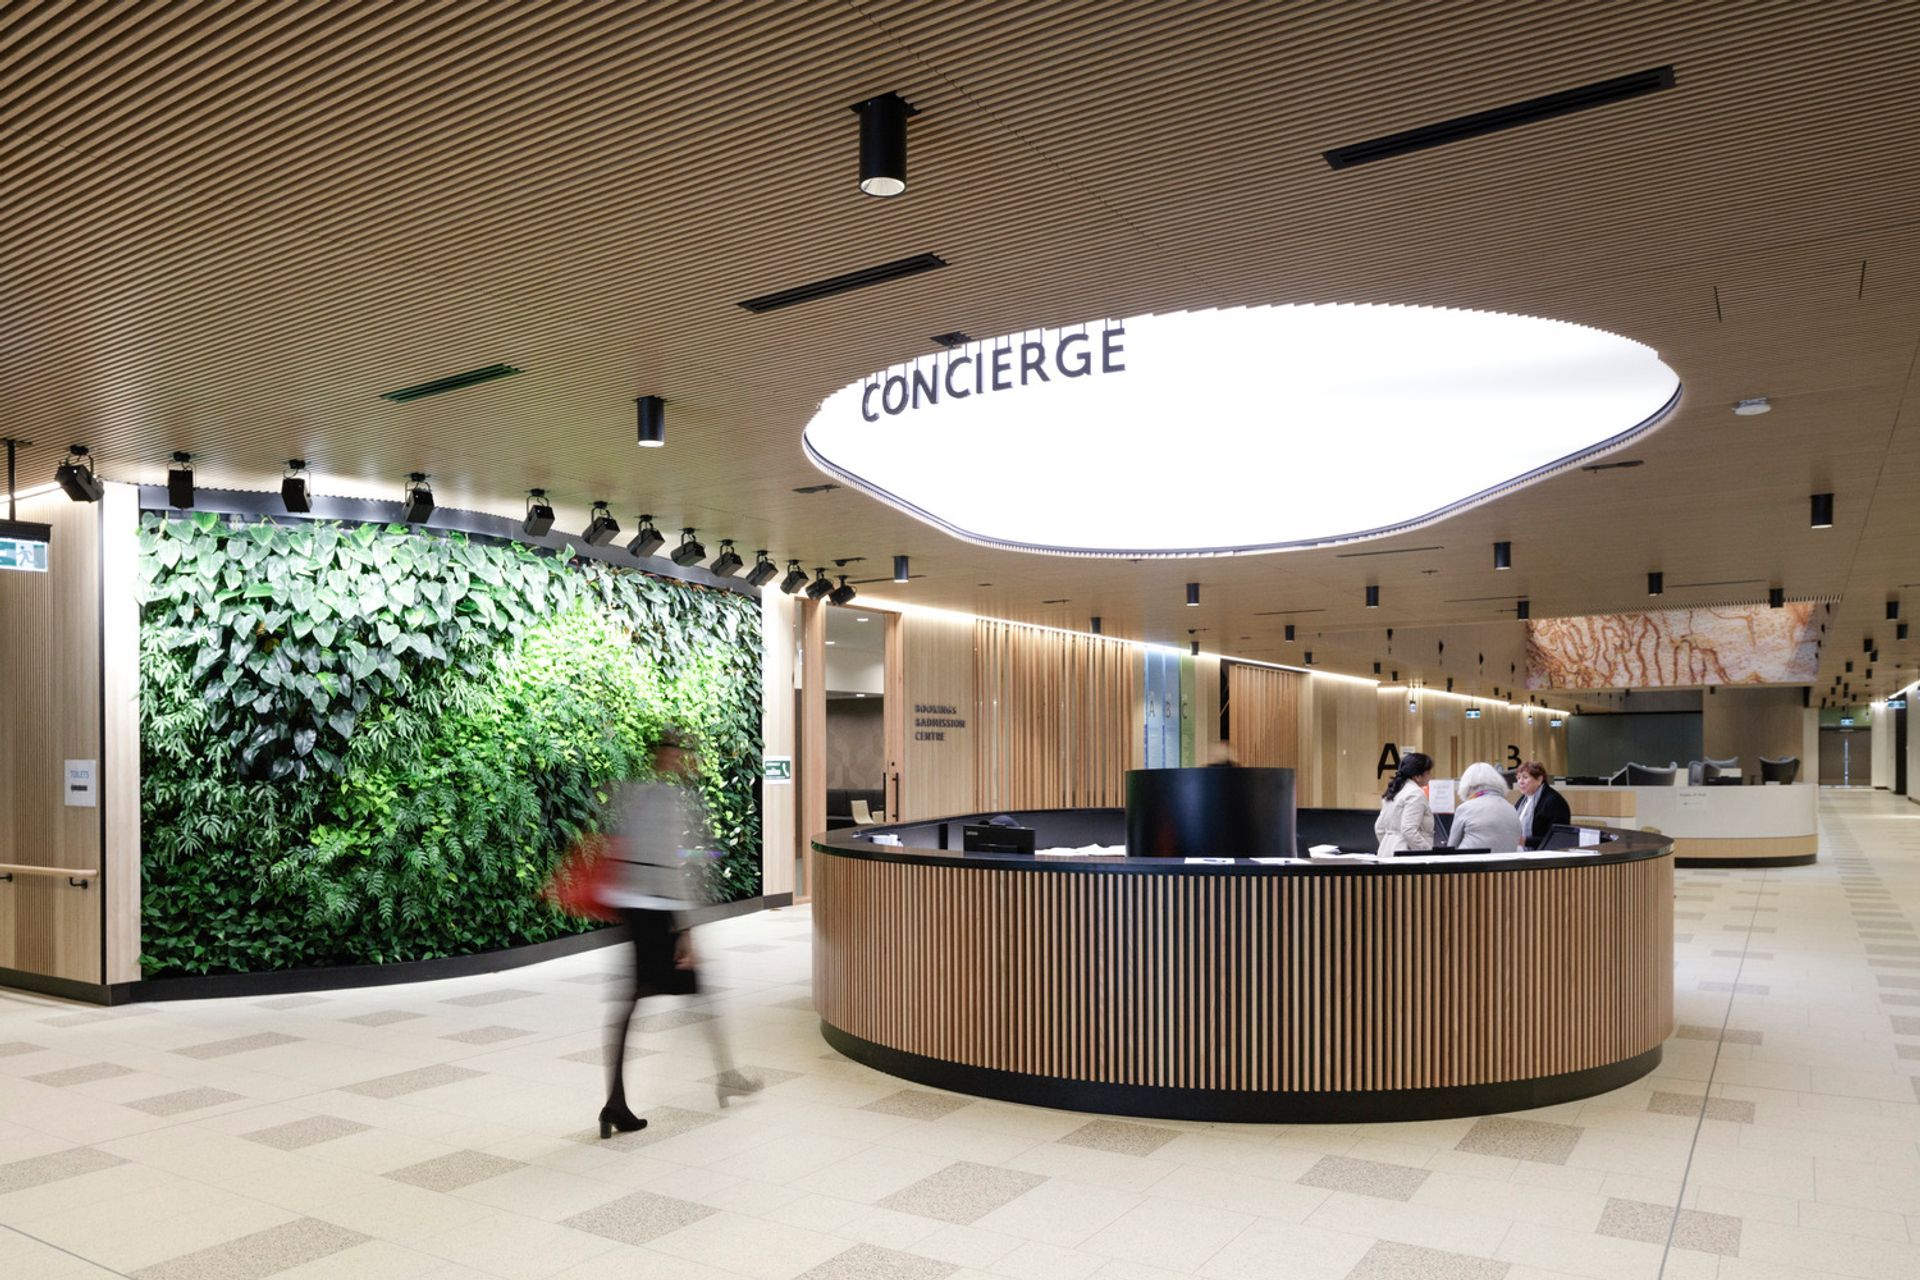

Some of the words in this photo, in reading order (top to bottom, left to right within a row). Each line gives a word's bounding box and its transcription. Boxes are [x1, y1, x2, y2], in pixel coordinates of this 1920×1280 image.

[861, 328, 1126, 422] CONCIERGE
[914, 731, 945, 741] CENTRE
[1377, 742, 1401, 780] A
